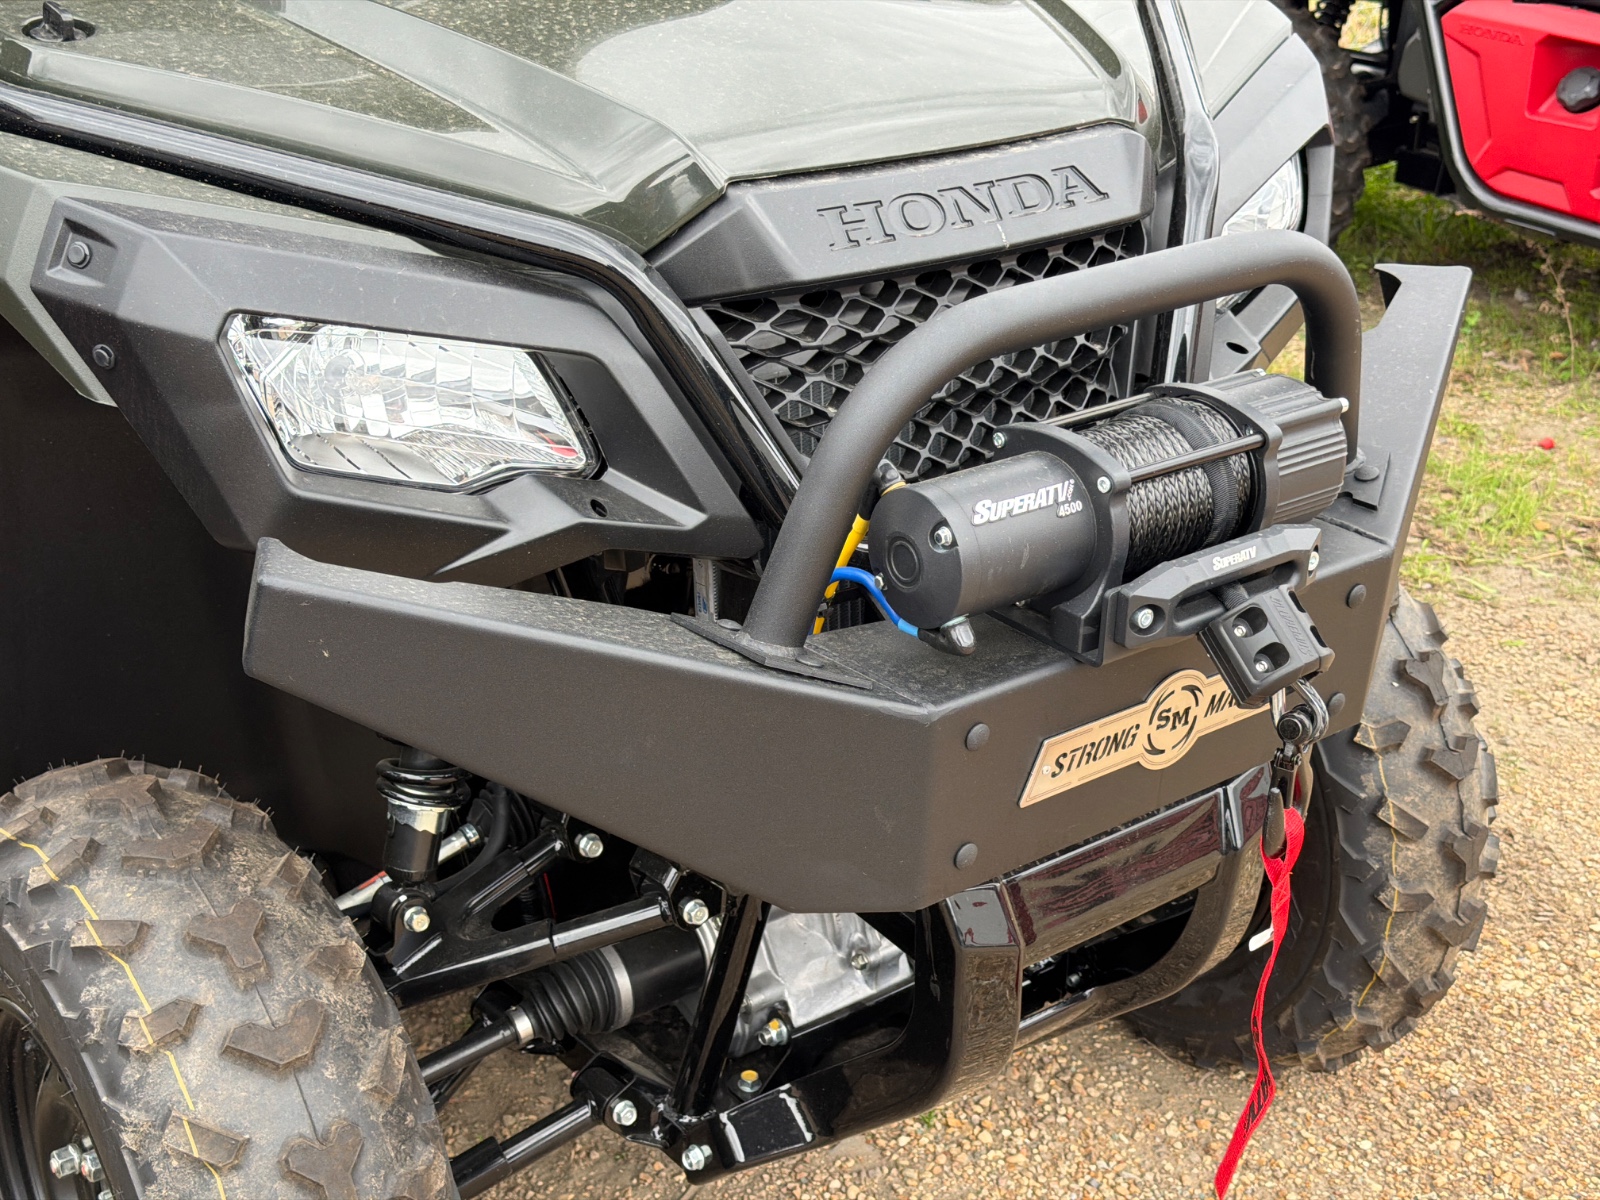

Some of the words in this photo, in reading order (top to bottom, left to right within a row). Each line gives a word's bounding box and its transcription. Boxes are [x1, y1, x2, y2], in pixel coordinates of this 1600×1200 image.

[1459, 23, 1525, 47] HONDA
[816, 164, 1110, 251] HONDA
[972, 481, 1069, 526] SUPERATV
[1058, 500, 1083, 517] 4500
[1212, 545, 1257, 571] SUPERATV
[1155, 705, 1192, 732] SM
[1050, 723, 1141, 779] STRONG
